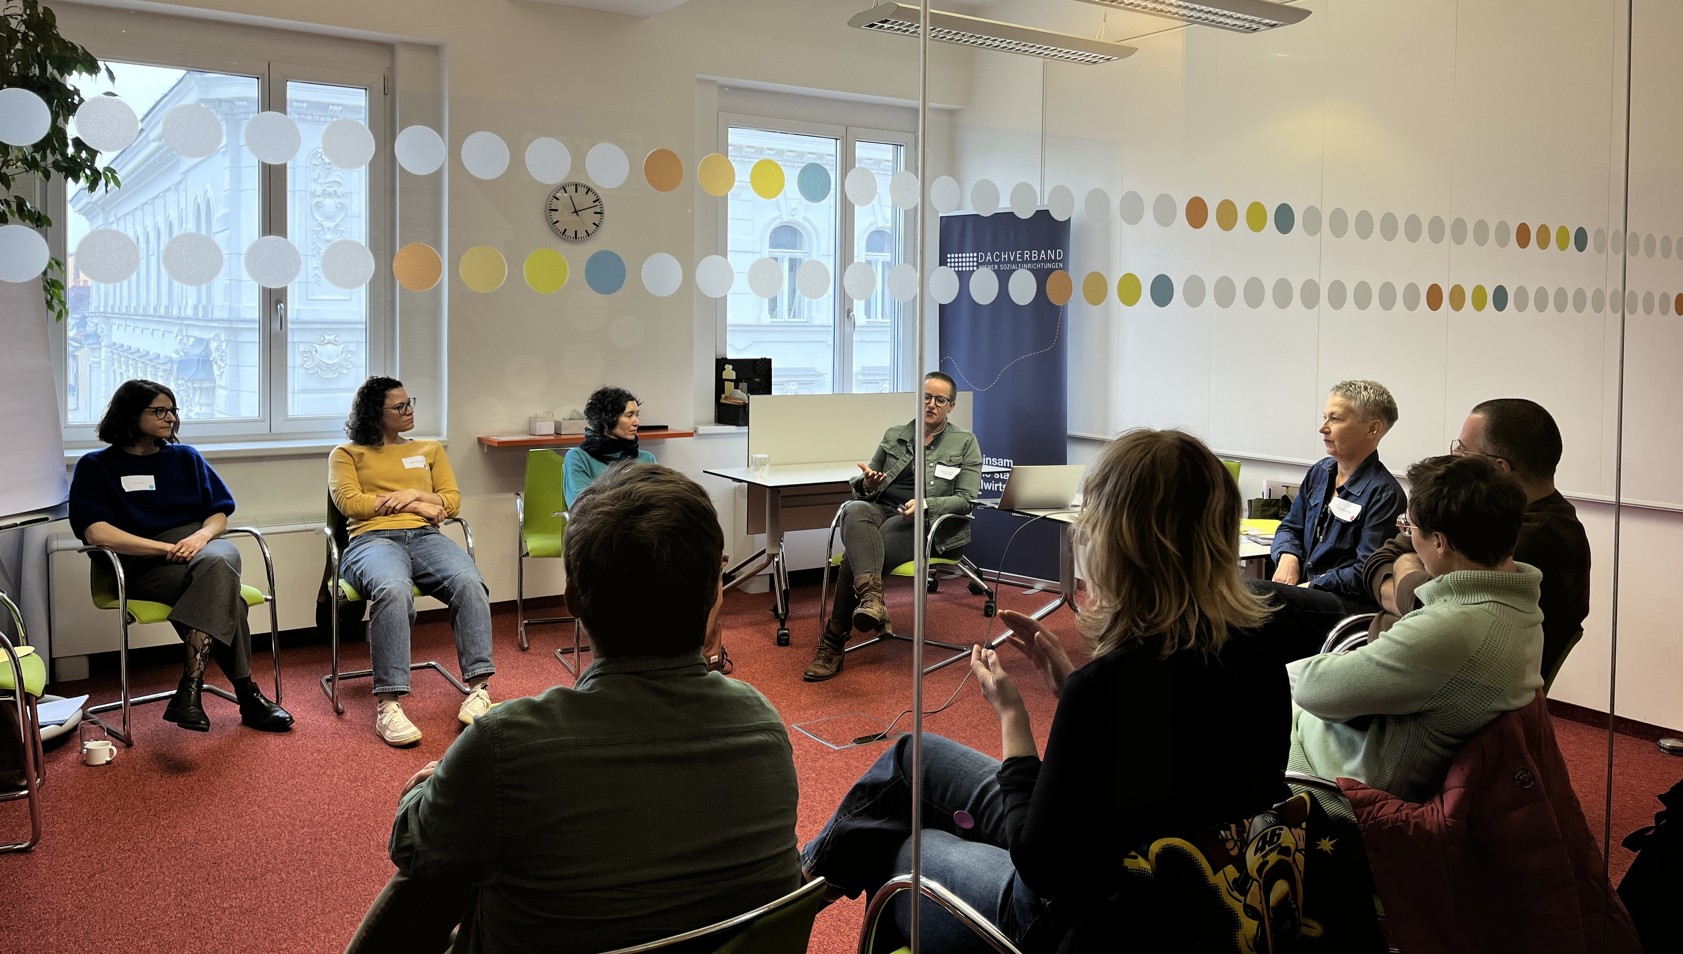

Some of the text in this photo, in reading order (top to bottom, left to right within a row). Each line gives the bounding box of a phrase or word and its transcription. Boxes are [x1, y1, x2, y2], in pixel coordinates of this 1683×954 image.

[978, 249, 1064, 262] DACHVERBAND
[1000, 262, 1063, 271] SOZIALEINRICHTUNGEN
[982, 454, 1014, 467] insam
[993, 472, 1010, 480] sta
[1254, 827, 1284, 857] 46
